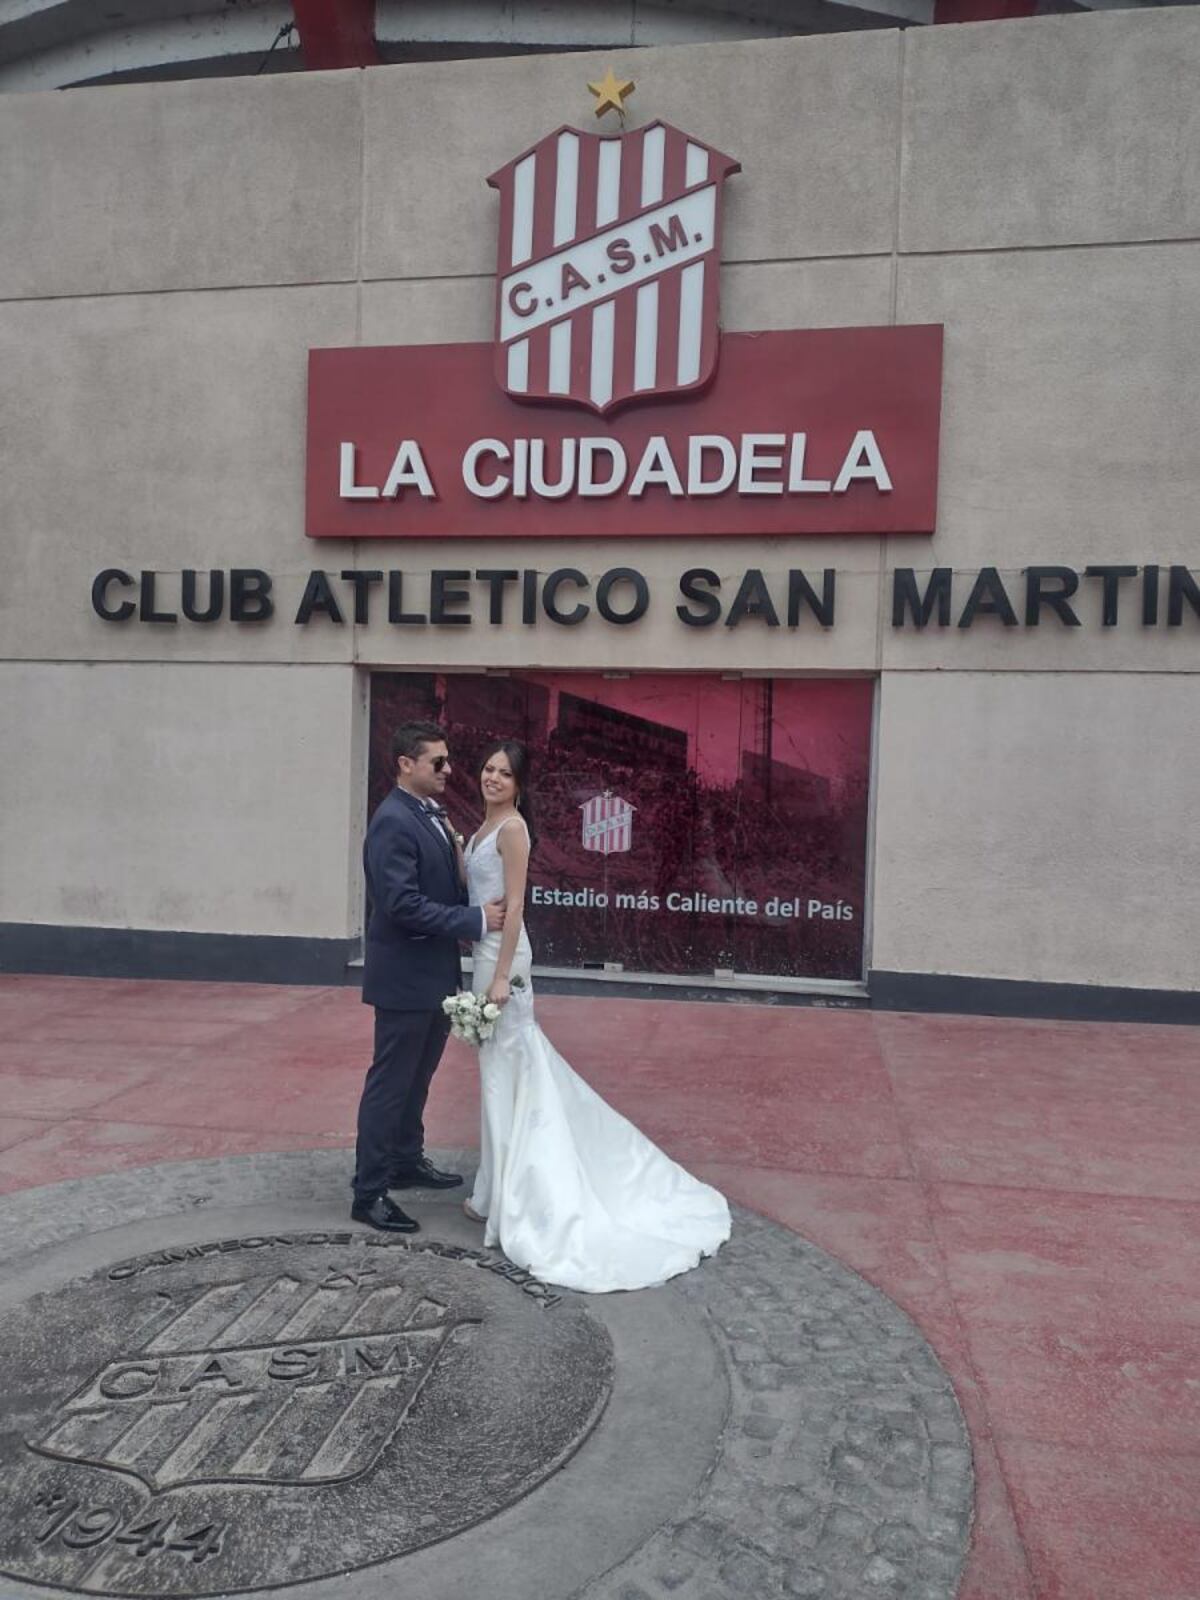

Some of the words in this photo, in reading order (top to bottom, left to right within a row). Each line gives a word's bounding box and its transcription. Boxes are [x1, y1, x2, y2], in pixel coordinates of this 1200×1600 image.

[507, 214, 703, 319] C.A.S.M.
[338, 440, 436, 501] LA
[462, 429, 894, 499] CIUDADELA
[91, 568, 275, 624] CLUB
[295, 567, 650, 627] ATLETICO
[676, 567, 836, 629] SAN
[892, 564, 1200, 628] MARTIN
[531, 886, 609, 908] Estadio
[615, 890, 660, 911] más
[666, 891, 758, 916] Caliente
[764, 896, 800, 919] del
[807, 899, 853, 921] País
[35, 1500, 230, 1563] 1944
